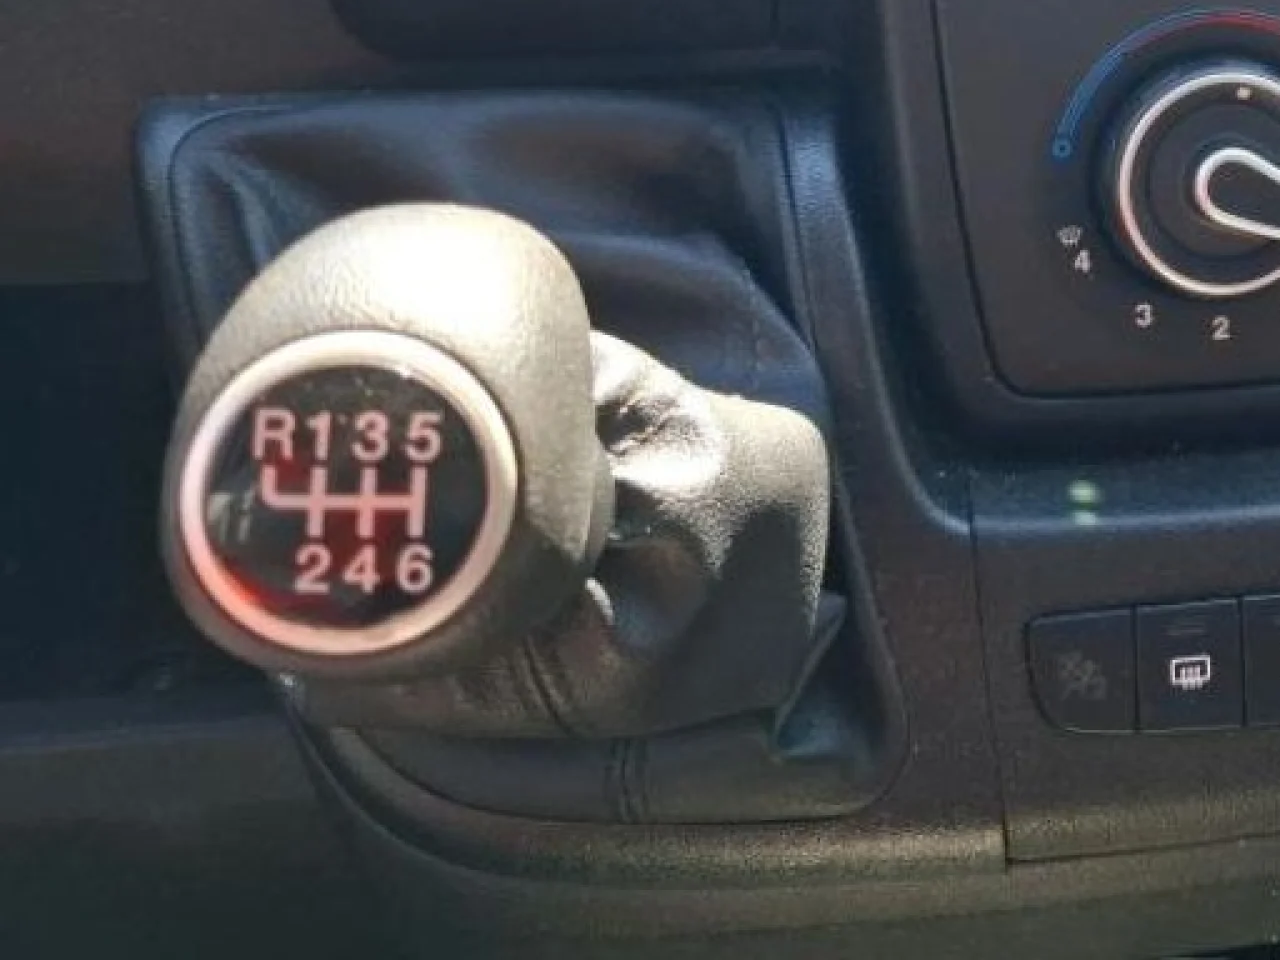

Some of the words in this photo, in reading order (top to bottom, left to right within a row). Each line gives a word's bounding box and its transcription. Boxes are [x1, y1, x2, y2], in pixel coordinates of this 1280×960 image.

[1073, 249, 1091, 273] 4
[1134, 302, 1153, 328] 3
[1212, 315, 1231, 340] 2
[254, 408, 296, 461] R
[307, 410, 332, 461] 1
[352, 410, 390, 462] 3
[405, 411, 442, 462] 5
[295, 544, 333, 594] 2
[342, 544, 380, 594] 4
[397, 543, 434, 594] 6
